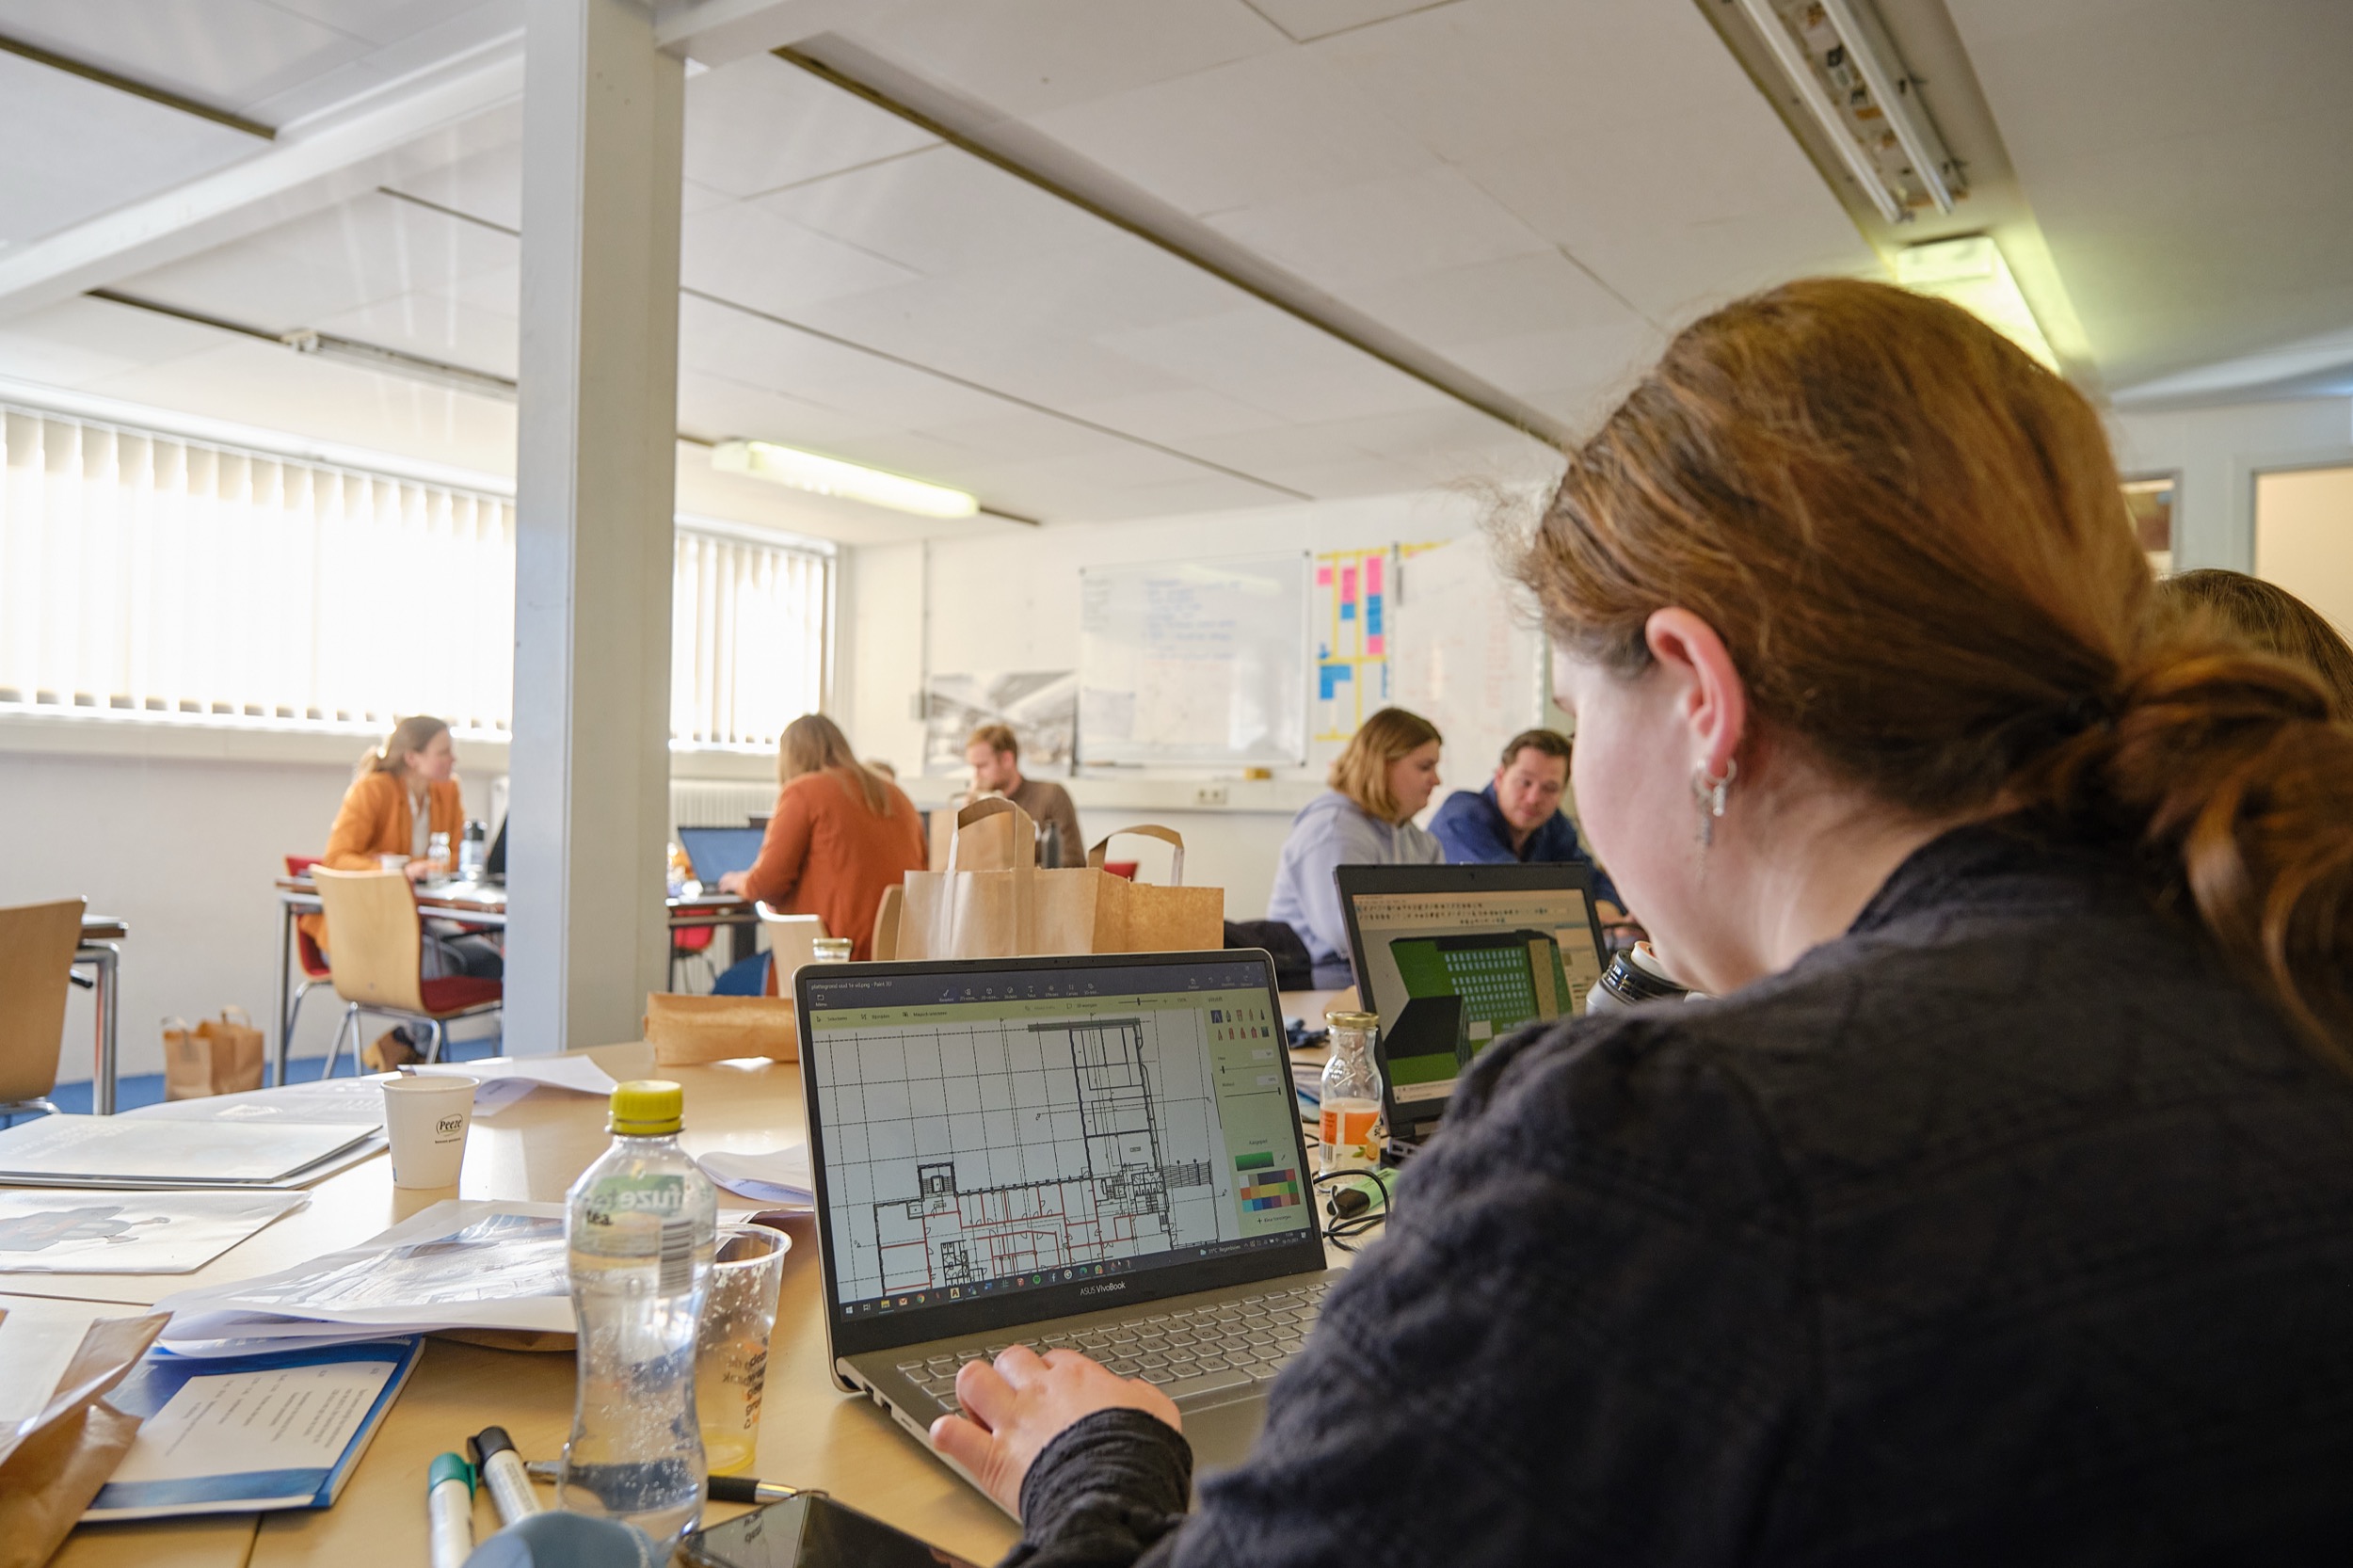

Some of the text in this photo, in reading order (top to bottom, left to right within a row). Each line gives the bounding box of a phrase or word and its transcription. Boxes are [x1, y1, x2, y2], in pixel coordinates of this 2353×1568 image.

[440, 1119, 462, 1131] Peeze
[1080, 1280, 1127, 1296] ASUS VivoBook
